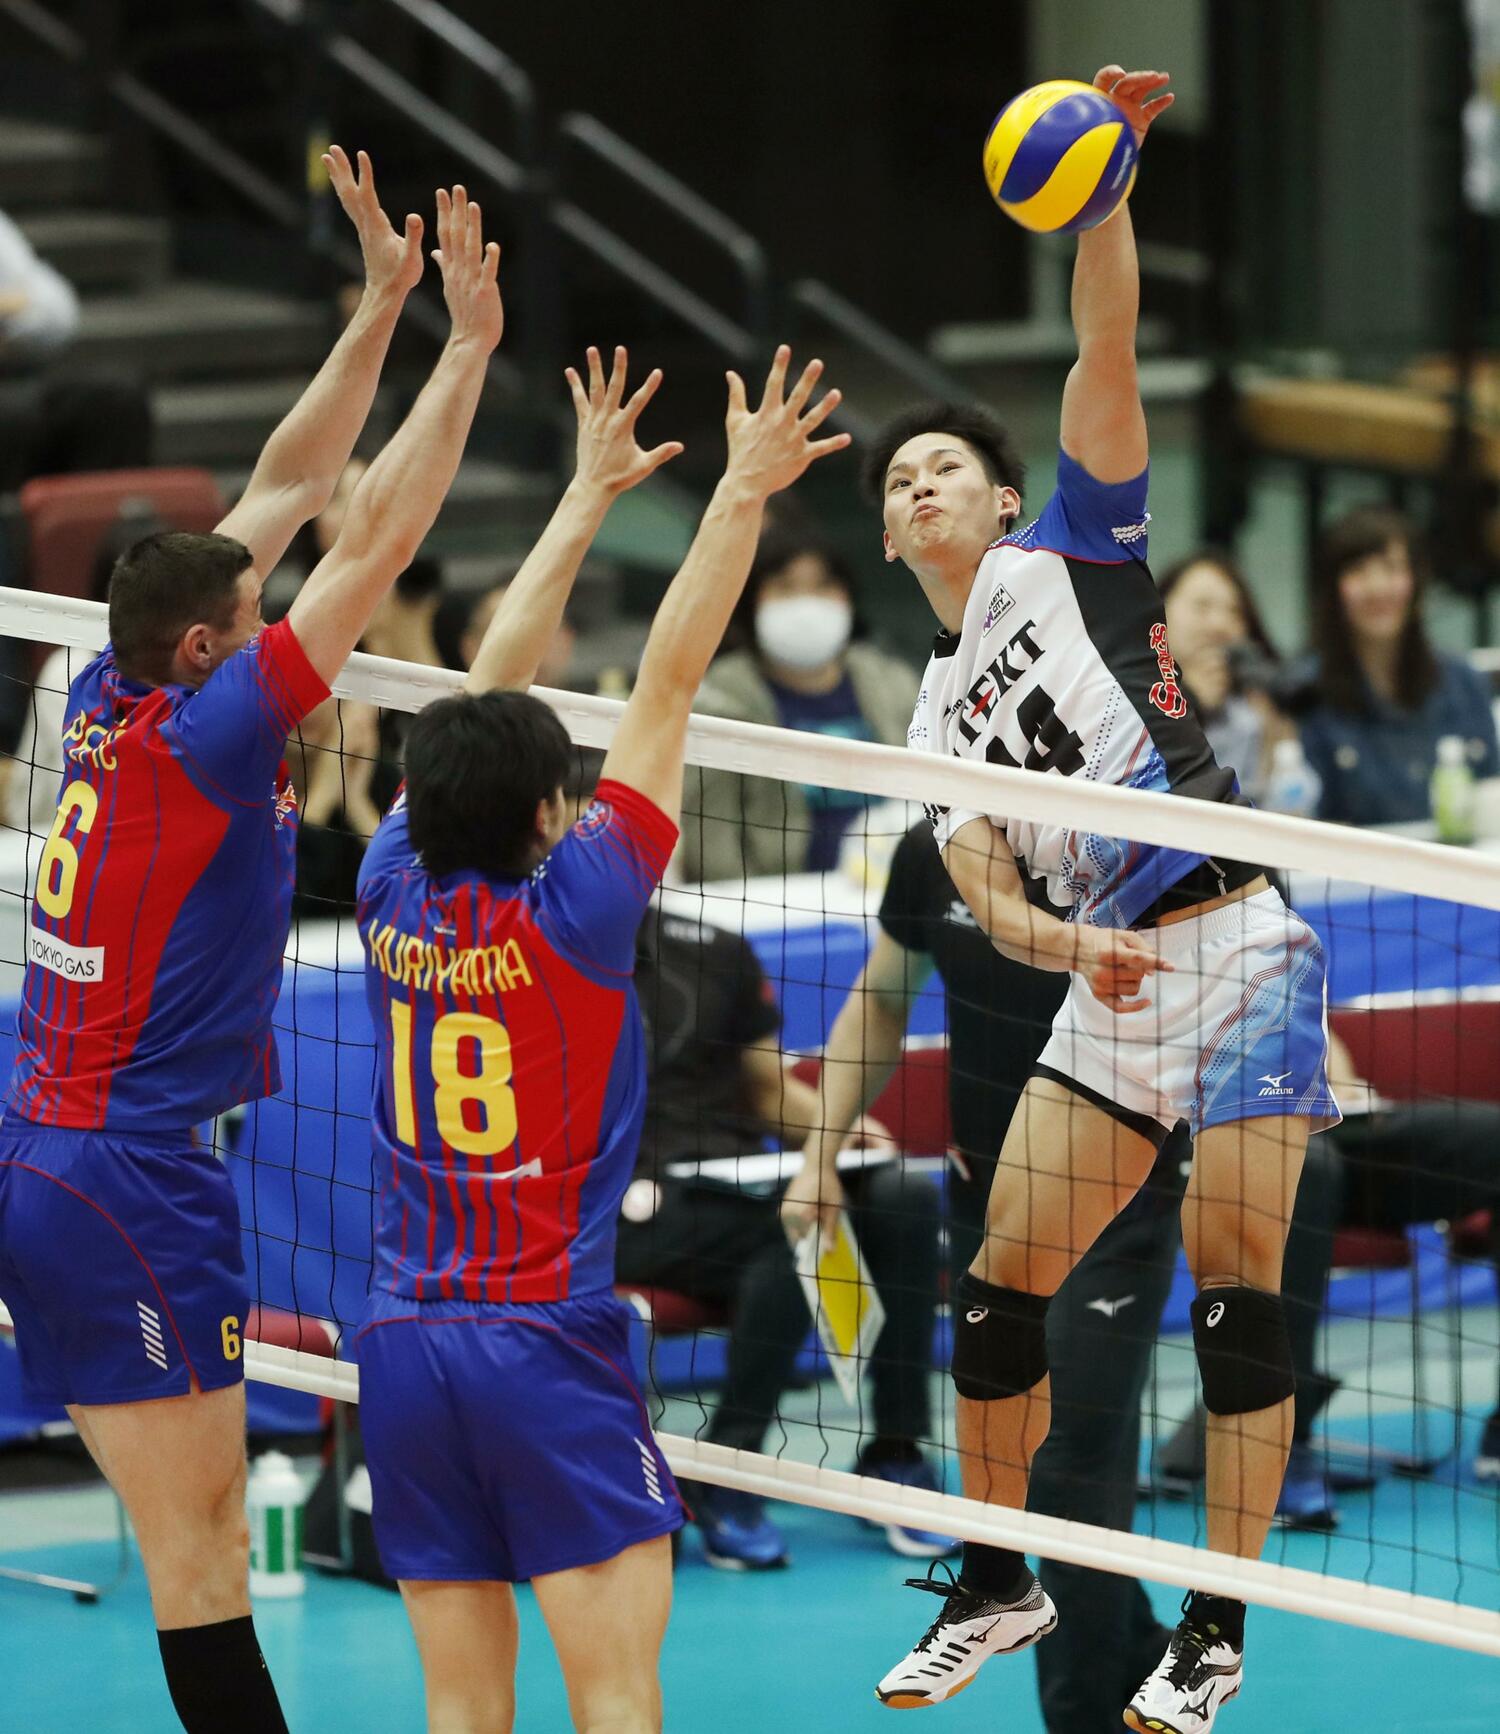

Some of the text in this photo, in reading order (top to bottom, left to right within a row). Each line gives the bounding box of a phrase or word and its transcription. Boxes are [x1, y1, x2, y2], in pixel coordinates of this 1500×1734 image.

[36, 780, 98, 919] 6
[32, 938, 95, 977] TOKYO GAS
[367, 919, 533, 996] KURIYAMA
[390, 998, 518, 1156] 18
[1258, 1087, 1294, 1097] MIZUNO
[221, 1315, 241, 1361] 6
